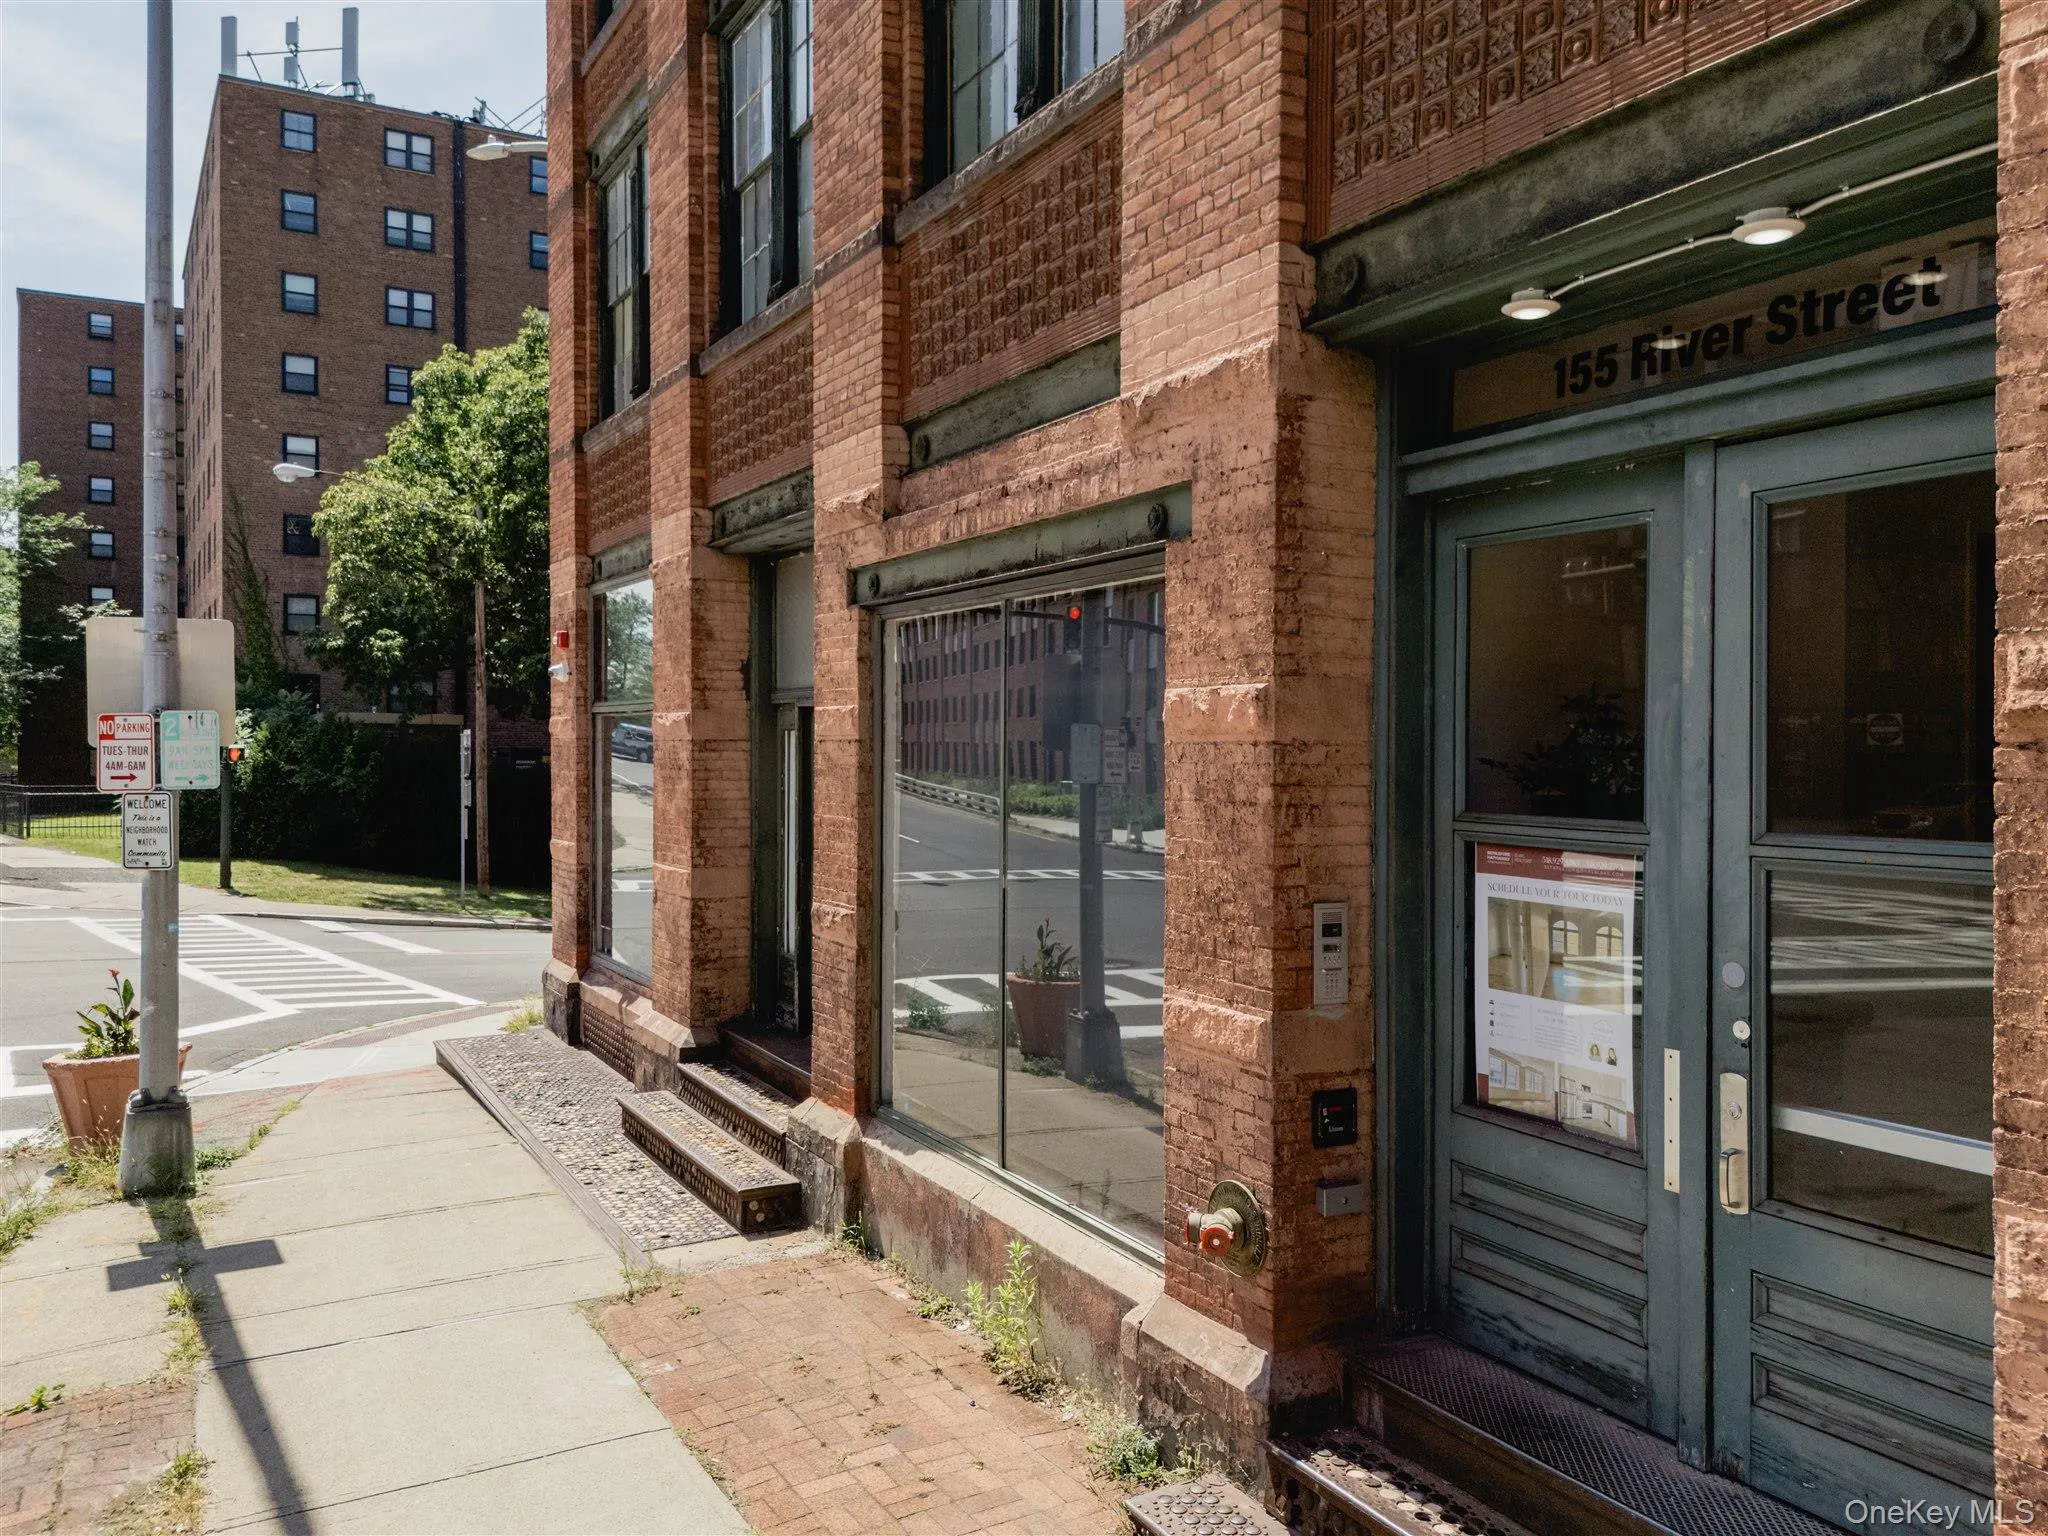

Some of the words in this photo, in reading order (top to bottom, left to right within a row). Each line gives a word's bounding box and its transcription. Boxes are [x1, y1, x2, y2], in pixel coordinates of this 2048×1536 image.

[1553, 349, 1620, 400] 155
[1630, 313, 1754, 381] River
[1765, 256, 1942, 346] Street
[99, 720, 115, 735] NO
[116, 722, 150, 733] PARKING
[164, 717, 177, 737] 2
[102, 745, 149, 756] TUES-THUR
[105, 761, 146, 771] 4AM-6AM
[127, 799, 168, 809] WELCOME
[126, 826, 168, 834] NEIGHBORHOOD
[128, 849, 167, 857] Community
[1487, 882, 1532, 896] SCHEDULE
[1534, 887, 1560, 899] YOUR
[1562, 889, 1589, 903] TOUR
[1591, 892, 1624, 907] TODAY
